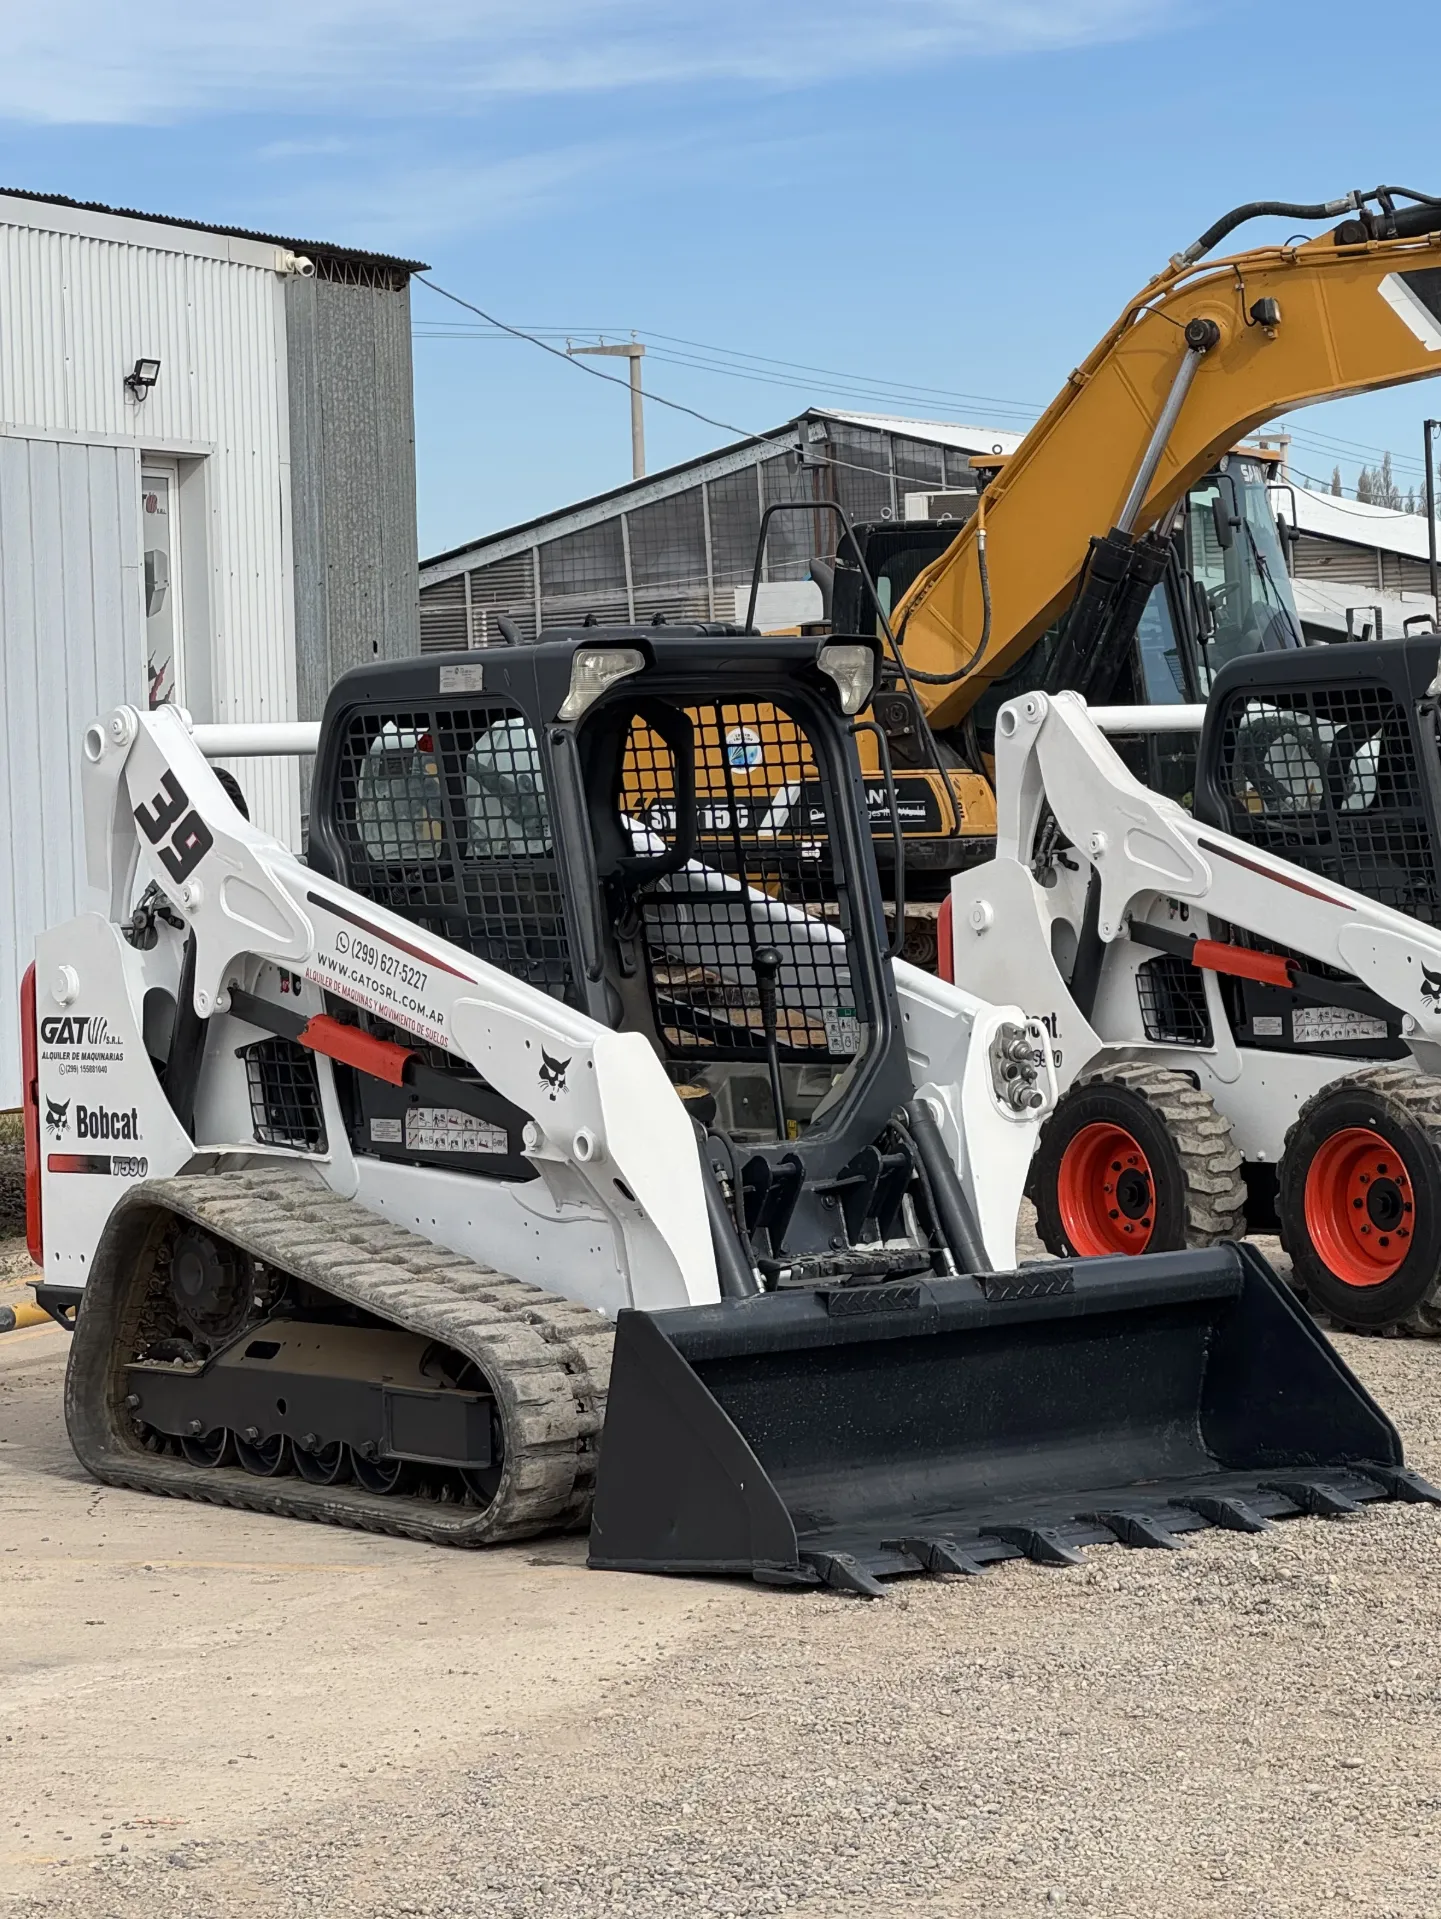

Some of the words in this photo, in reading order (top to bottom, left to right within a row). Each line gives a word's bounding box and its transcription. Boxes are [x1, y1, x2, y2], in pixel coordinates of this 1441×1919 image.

[351, 938, 379, 970] (299)
[380, 953, 428, 992] 627-5227
[317, 951, 445, 1026] WWW.GATOSRL.COM.AR
[305, 967, 333, 989] ALQUILER
[333, 980, 342, 994] DE
[341, 984, 374, 1009] MAQUINAS
[373, 999, 379, 1011] Y
[378, 1003, 416, 1031] MOVIMIENTO
[416, 1022, 425, 1036] DE
[425, 1027, 449, 1048] SUELOS
[105, 1035, 124, 1045] S.R.L.
[41, 1051, 71, 1061] ALQUILER
[71, 1052, 80, 1061] DE
[80, 1052, 124, 1062] MAQUINARIAS
[65, 1064, 79, 1075] (299)
[76, 1105, 138, 1141] Bobcat
[112, 1155, 149, 1178] T590
